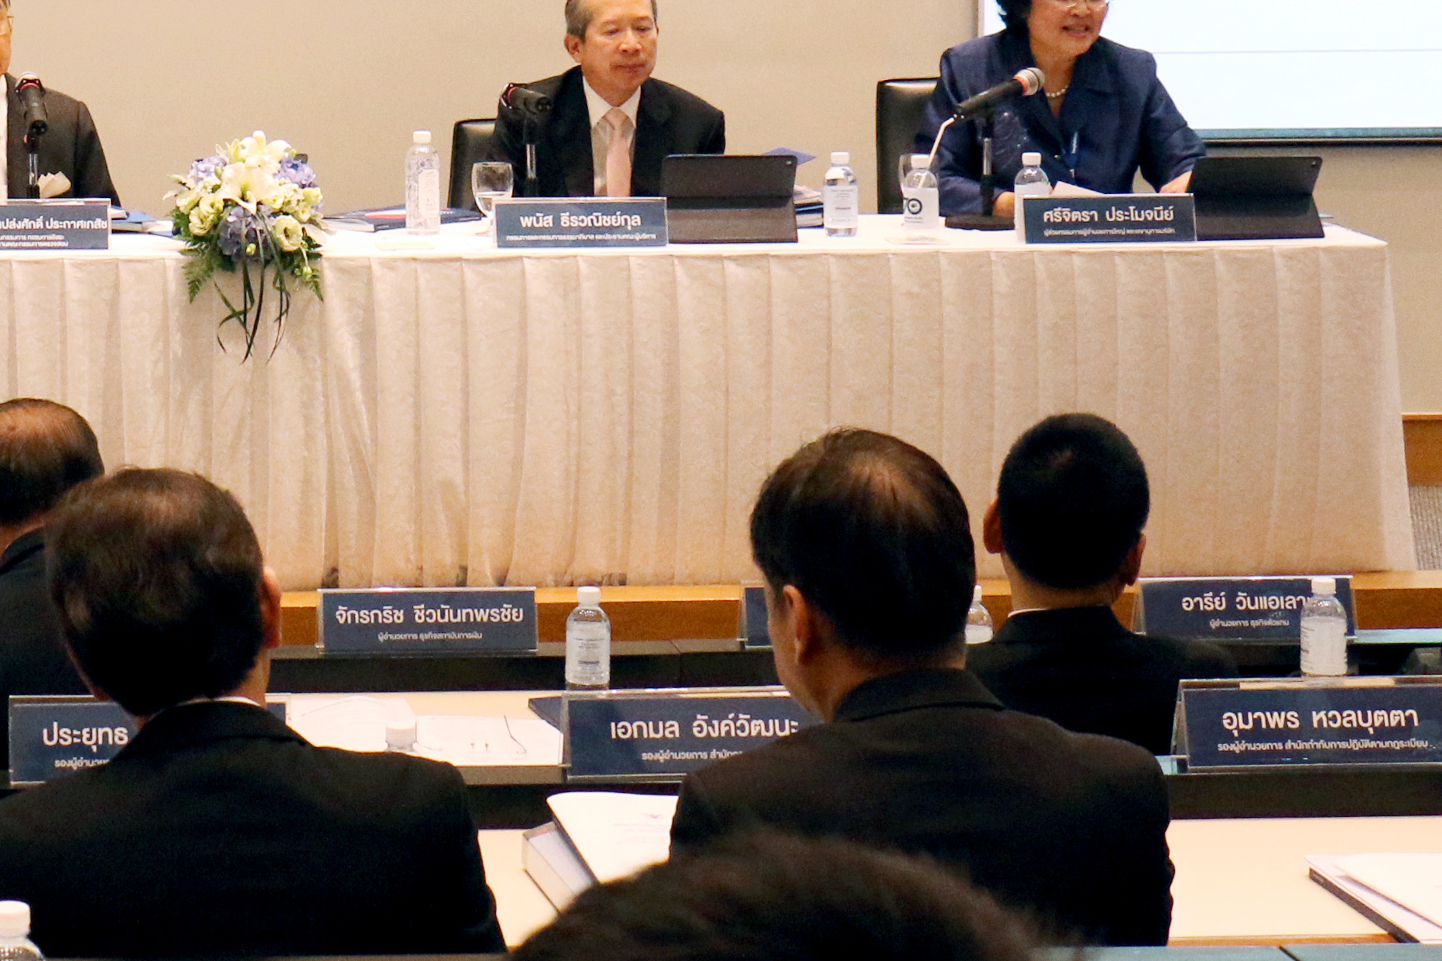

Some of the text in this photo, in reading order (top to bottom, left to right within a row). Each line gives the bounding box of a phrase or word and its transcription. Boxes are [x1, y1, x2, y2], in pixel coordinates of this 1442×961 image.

[519, 210, 642, 231] พนัส ธีรวณิชย์กุล
[1043, 205, 1174, 223] ศรีจิตรา ประโมจนีย์
[1181, 590, 1308, 612] อารีย์ วันแอเลา
[335, 603, 524, 624] จักรกริช ชีวนันทพรชัย
[610, 712, 799, 739] เอกมล อังค์วัฒนะ
[1222, 708, 1419, 737] อุมาพร หวลบุตตา
[42, 721, 129, 753] ประยุทธ
